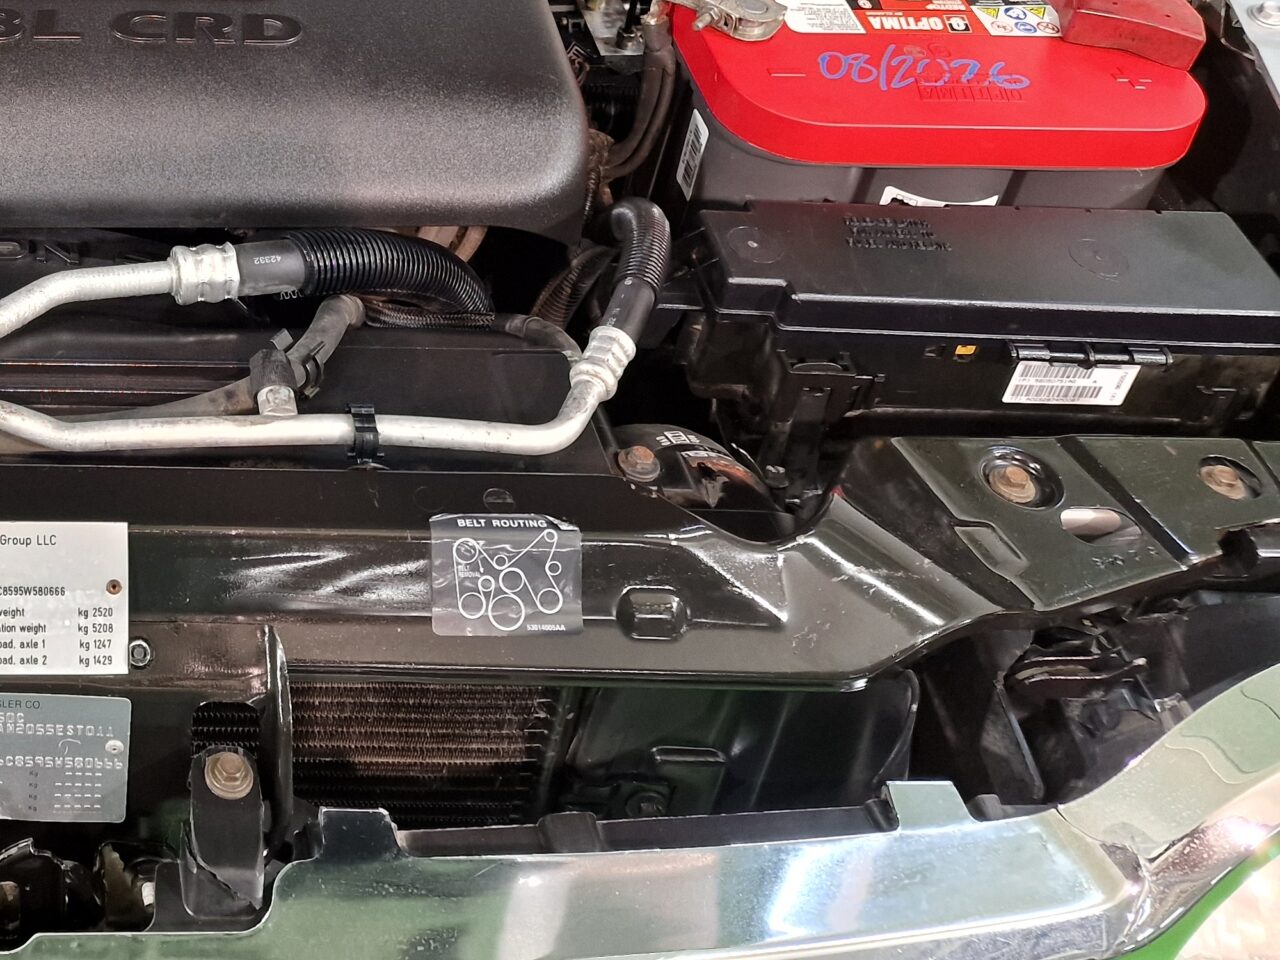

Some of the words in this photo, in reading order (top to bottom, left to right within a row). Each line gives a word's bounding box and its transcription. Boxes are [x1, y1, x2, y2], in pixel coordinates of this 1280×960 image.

[867, 16, 944, 30] OPTIMA
[110, 11, 303, 48] CRD
[252, 255, 282, 265] 42332
[457, 519, 486, 527] BELT
[492, 519, 548, 528] ROUTING
[0, 534, 32, 547] Group
[36, 534, 57, 546] LLC
[78, 607, 89, 619] kg
[92, 607, 113, 617] 2520
[19, 623, 46, 635] weight
[77, 623, 89, 635] kg
[92, 623, 114, 633] 5208
[19, 639, 39, 649] axle
[41, 639, 46, 648] 1
[79, 639, 90, 651] kg
[93, 639, 112, 649] 1247
[19, 655, 39, 665] axle
[42, 655, 48, 665] 2
[79, 655, 90, 667] kg
[93, 655, 113, 665] 1429
